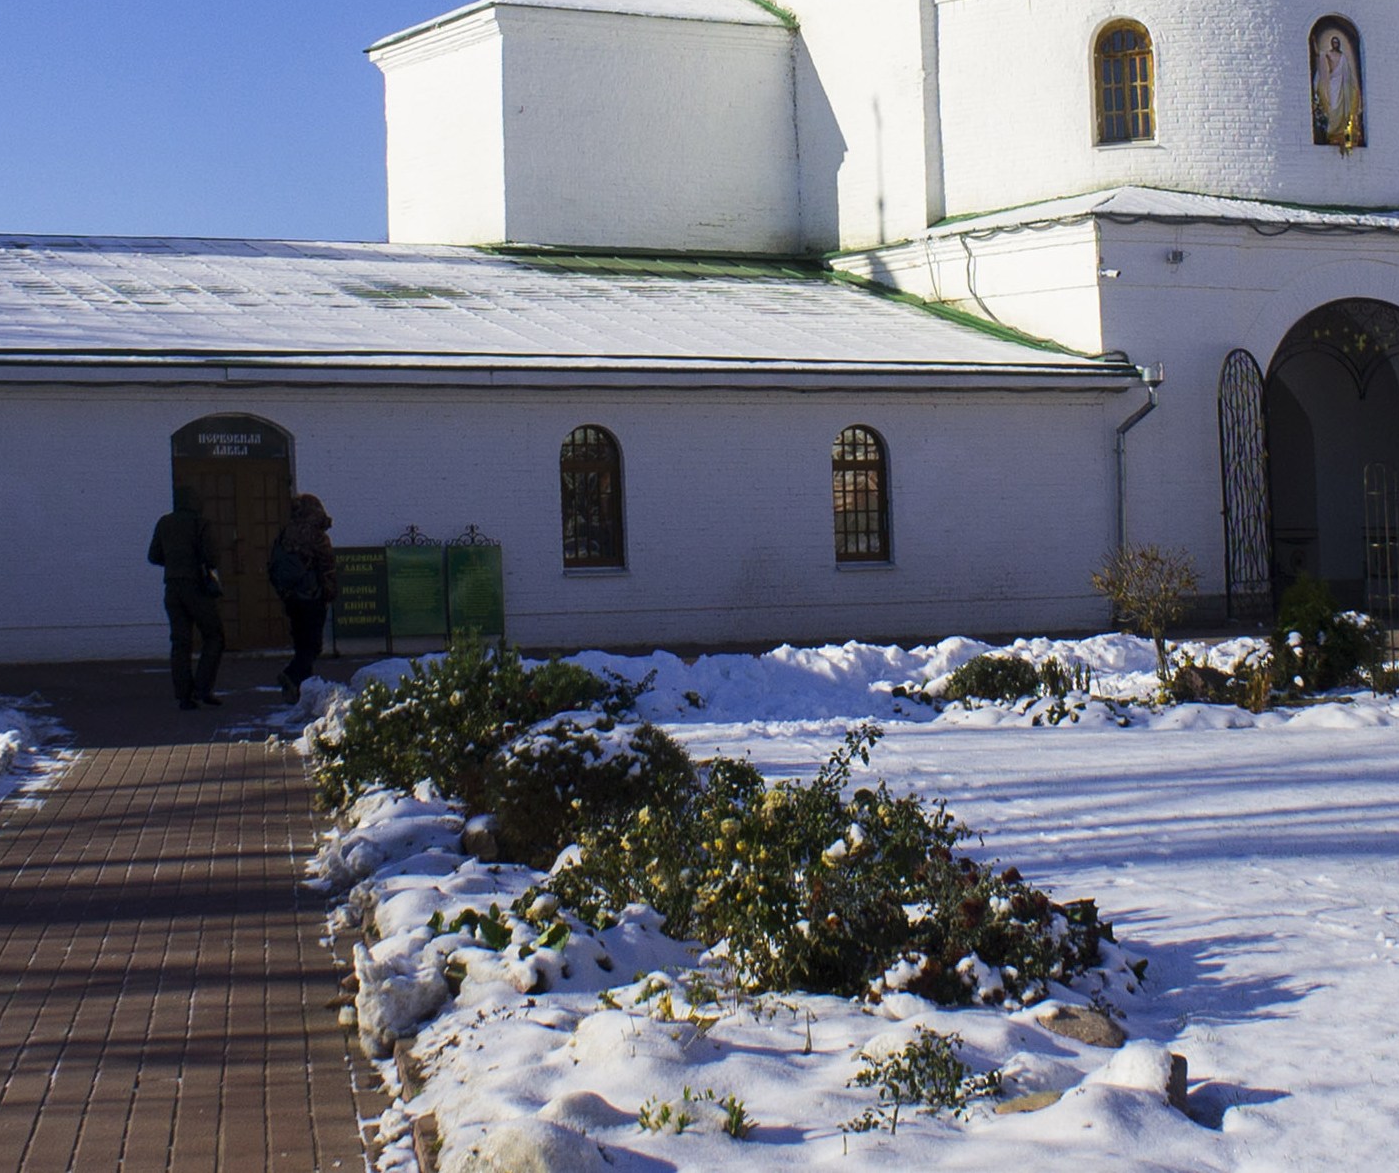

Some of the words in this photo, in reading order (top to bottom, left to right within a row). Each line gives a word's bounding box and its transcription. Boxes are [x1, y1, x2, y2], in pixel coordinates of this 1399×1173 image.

[198, 433, 261, 444] ЦЕРКОВНАЯ
[212, 444, 248, 456] ЛАВКА
[342, 585, 376, 595] ИКОНЫ
[344, 601, 376, 610] КНИГИ
